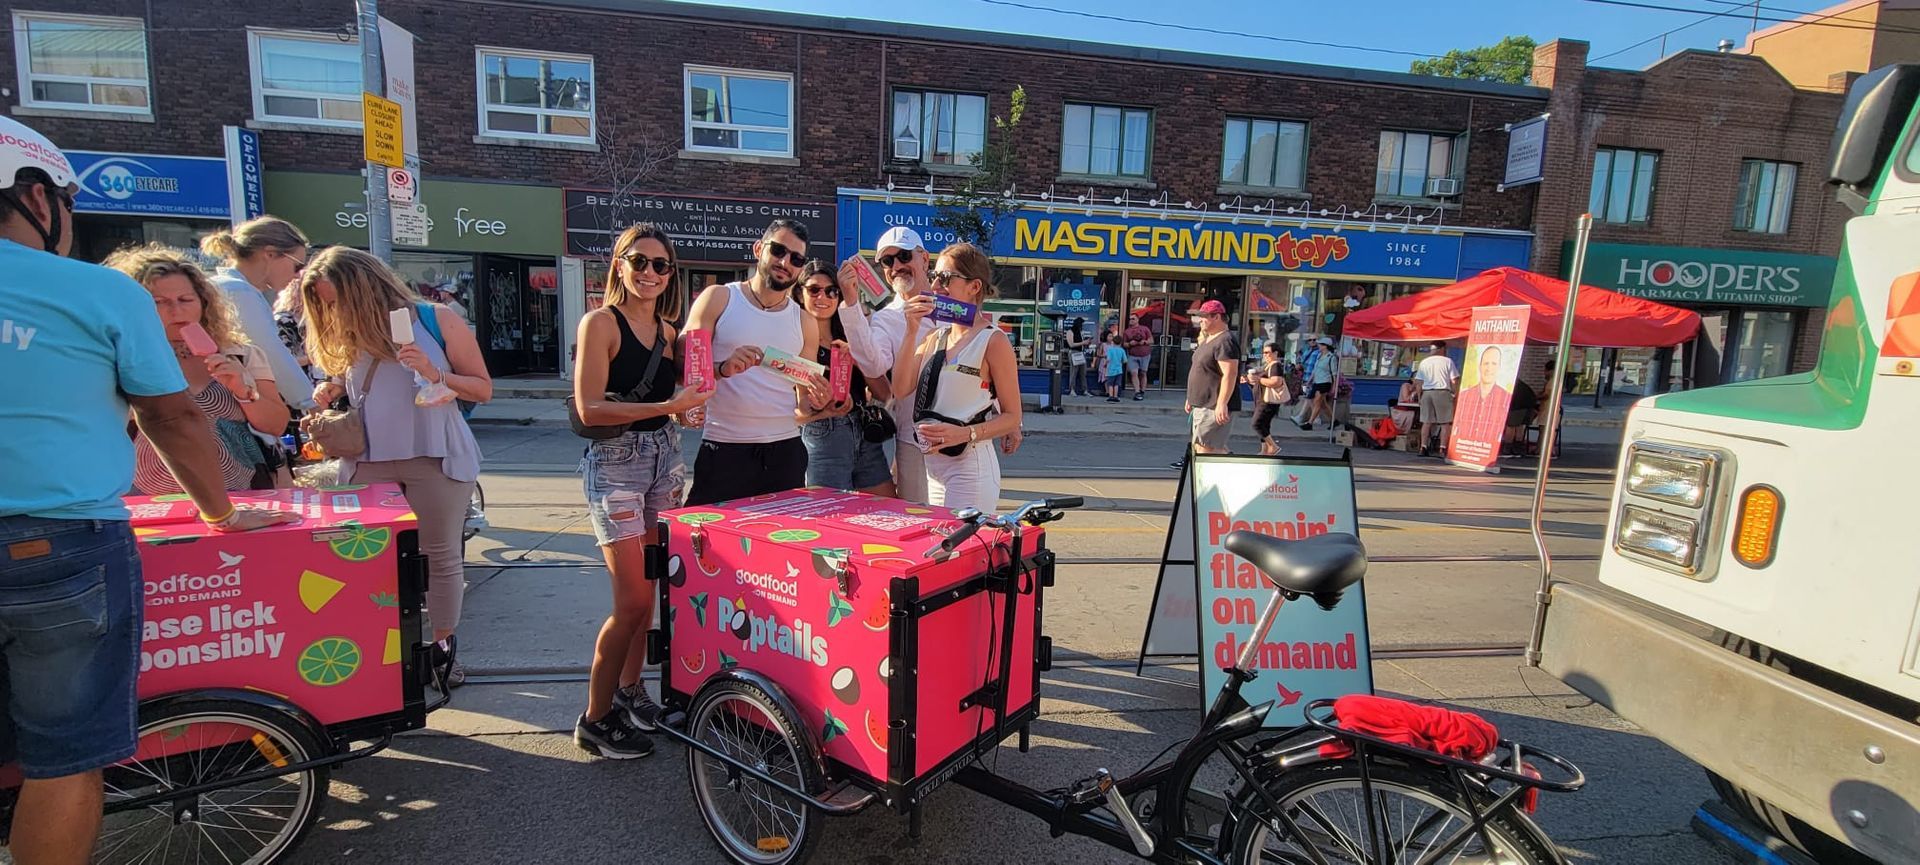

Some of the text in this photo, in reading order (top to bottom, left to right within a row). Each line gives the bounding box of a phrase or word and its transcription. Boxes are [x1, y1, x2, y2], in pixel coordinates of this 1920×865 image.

[368, 100, 399, 116] CURB LANE
[371, 109, 396, 123] CLOSURE
[375, 119, 393, 129] AHEAD
[376, 130, 393, 141] SLOW
[376, 140, 394, 151] DOWN
[586, 195, 820, 218] BEACHES WELLNESS CENTRE
[454, 207, 507, 238] free
[732, 225, 766, 236] ASSOC
[696, 241, 744, 250] MASSAGE
[1014, 218, 1350, 270] MASTERMIND toys
[1386, 242, 1428, 254] SINCE
[1389, 256, 1421, 266] 1984
[1617, 258, 1801, 300] HOOPER'S
[1056, 299, 1096, 307] CURBSIDE
[1617, 288, 1798, 304] PHARMACY VITAMIN SHOP
[1474, 319, 1521, 333] NATHANIEL
[1210, 552, 1275, 590] flav
[144, 569, 242, 596] odfood
[735, 569, 798, 597] goodfood
[178, 588, 242, 603] DEMAND
[767, 592, 798, 607] DEMAND
[1212, 597, 1257, 625] on
[141, 601, 277, 643] ase lick
